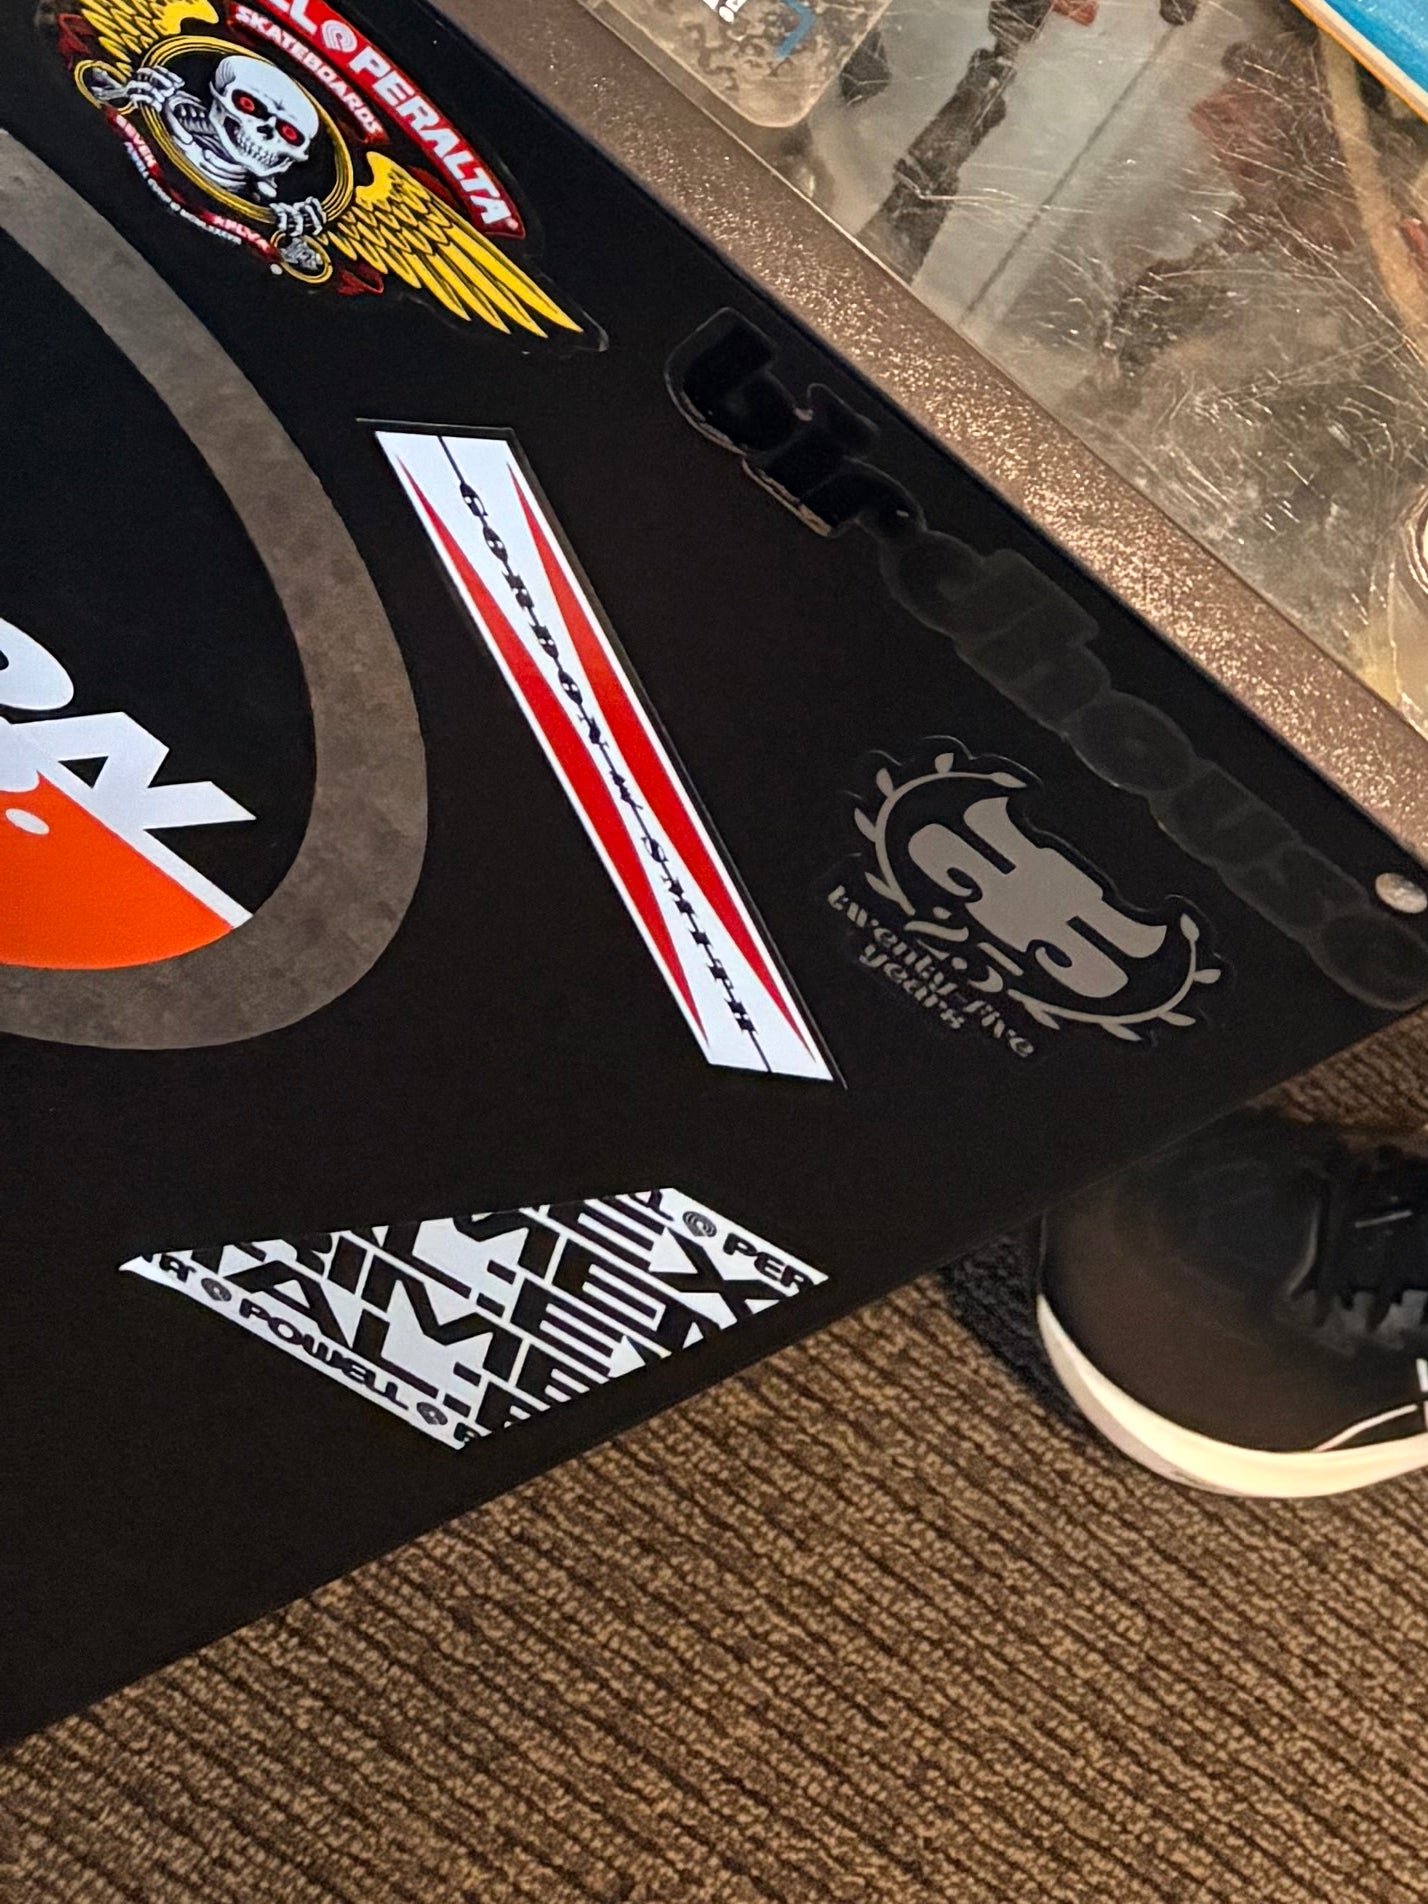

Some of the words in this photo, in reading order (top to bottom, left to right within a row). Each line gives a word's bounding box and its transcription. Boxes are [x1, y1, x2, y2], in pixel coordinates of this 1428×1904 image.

[234, 4, 384, 134] SKATEBOARDS
[350, 47, 513, 224] PERALTA
[857, 942, 967, 1034] years
[236, 1297, 417, 1412] POWELL
